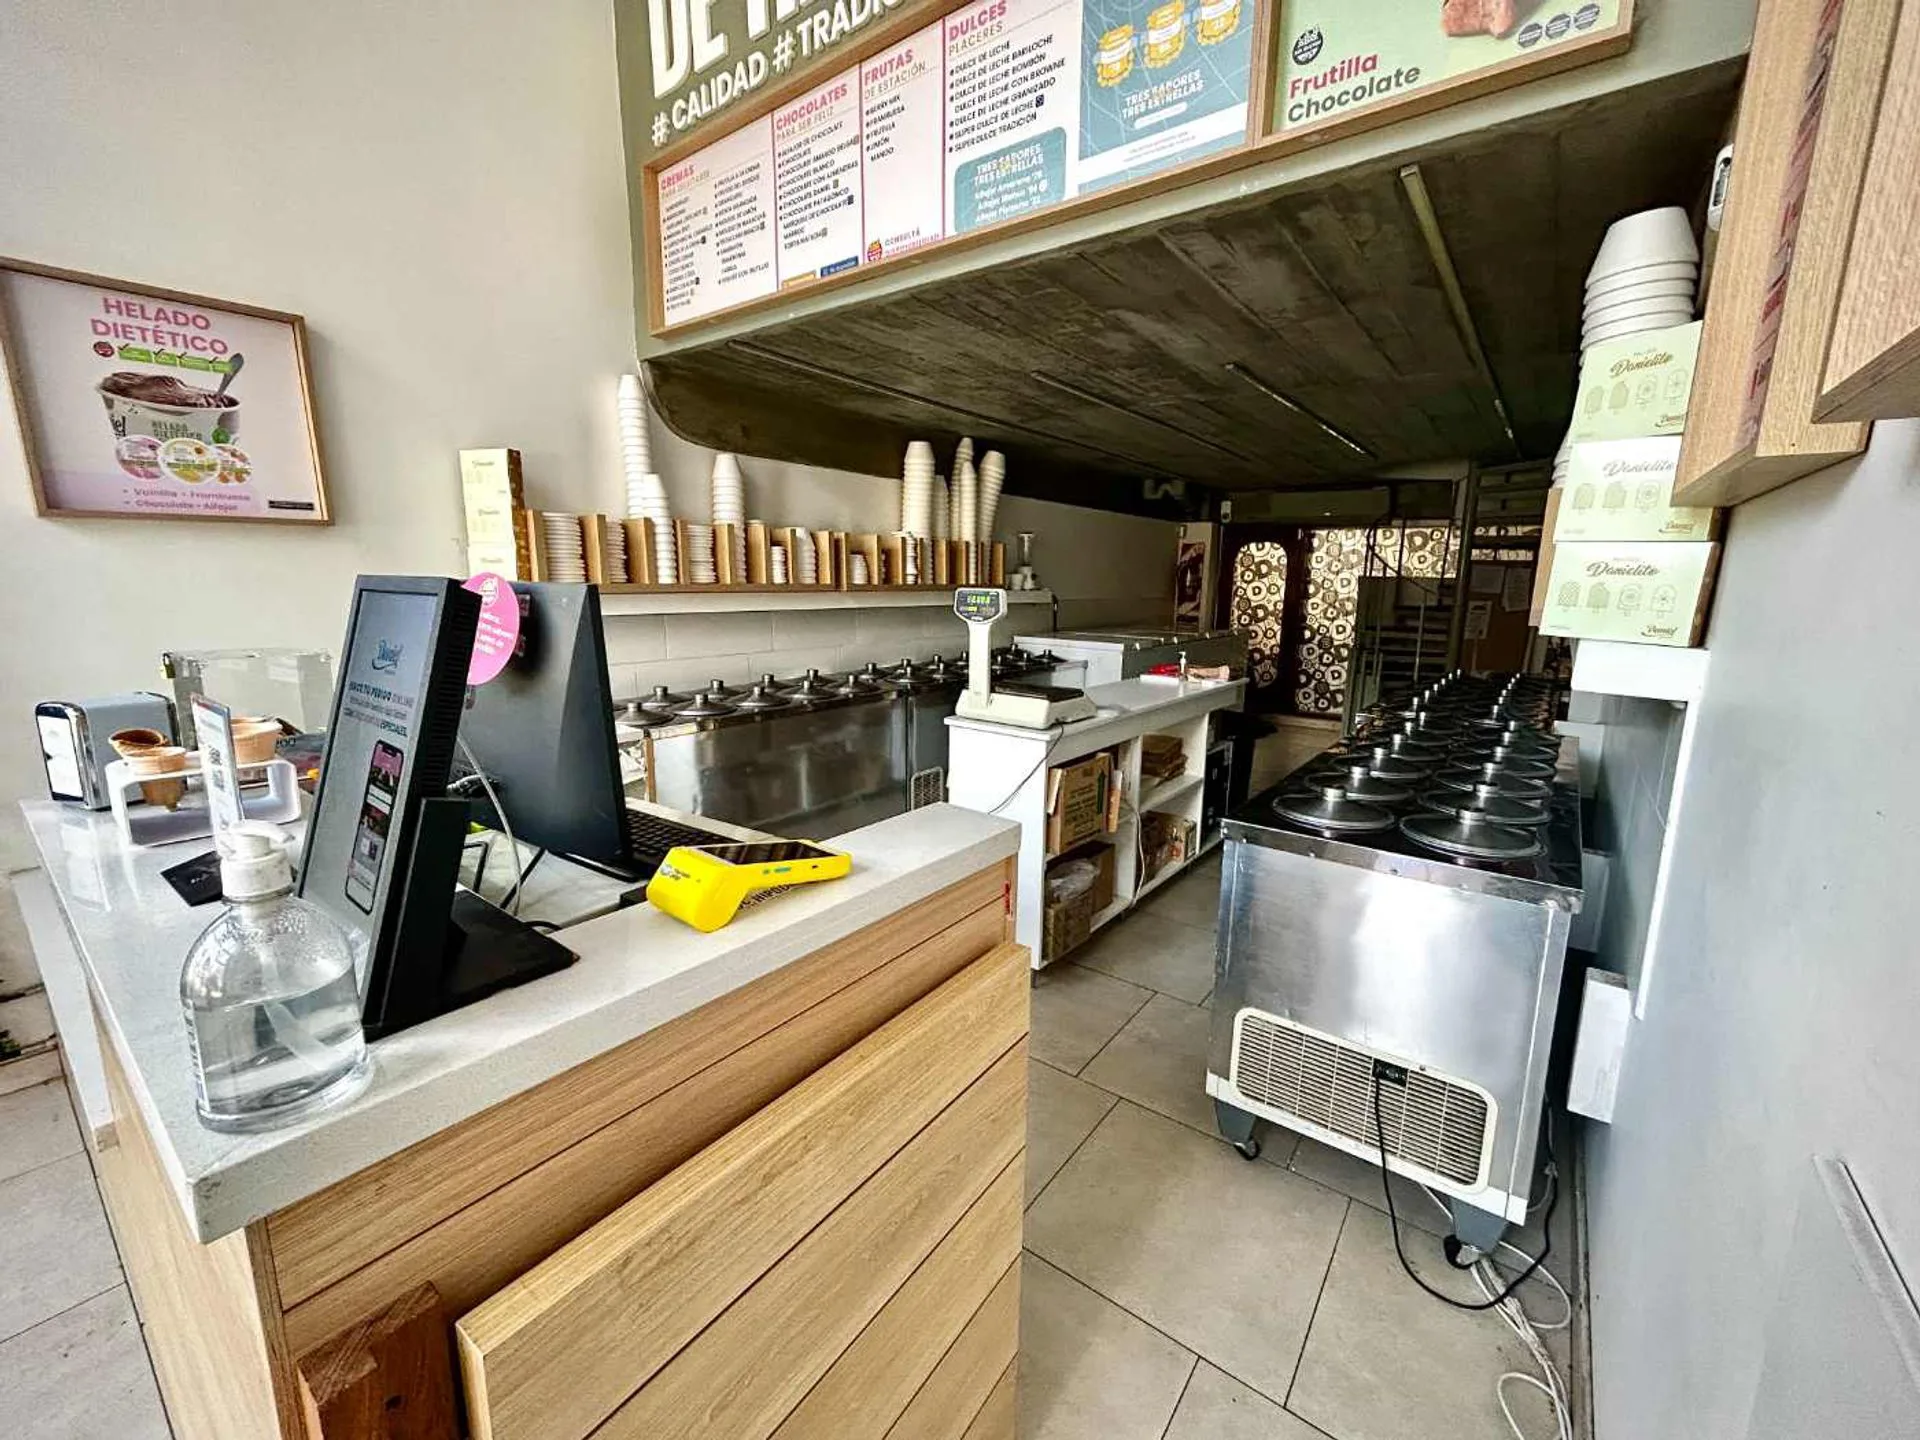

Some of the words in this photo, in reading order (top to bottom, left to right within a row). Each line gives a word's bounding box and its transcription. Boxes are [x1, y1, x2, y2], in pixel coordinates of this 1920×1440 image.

[772, 0, 904, 74] #TRAD
[949, 1, 1007, 41] DULCES
[949, 21, 1003, 56] PLACERES
[864, 49, 914, 86] FRUTAS
[955, 58, 976, 74] DULCE
[989, 41, 1010, 58] LECHE
[955, 71, 976, 87] DULCE
[989, 55, 1010, 71] LECHE
[1288, 53, 1379, 99] Frutilla
[864, 86, 876, 100] DE
[879, 61, 926, 93] ESTACIÓN
[955, 85, 976, 100] DULCE
[989, 69, 1010, 85] LECHE
[955, 98, 976, 114] DULCE
[989, 83, 1009, 98] LECHE
[1011, 75, 1029, 89] CON
[1030, 57, 1065, 80] BROWNIE
[1288, 65, 1421, 123] Chocolate
[776, 84, 847, 130] CHOCOLATES
[955, 111, 976, 127] DULCE
[989, 97, 1009, 112] LECHE
[1010, 77, 1056, 102] GRANIZADO
[976, 116, 998, 131] DULCE
[1011, 100, 1033, 116] LECHE
[103, 297, 211, 330] HELADO
[90, 318, 228, 355] DIETÉTICO
